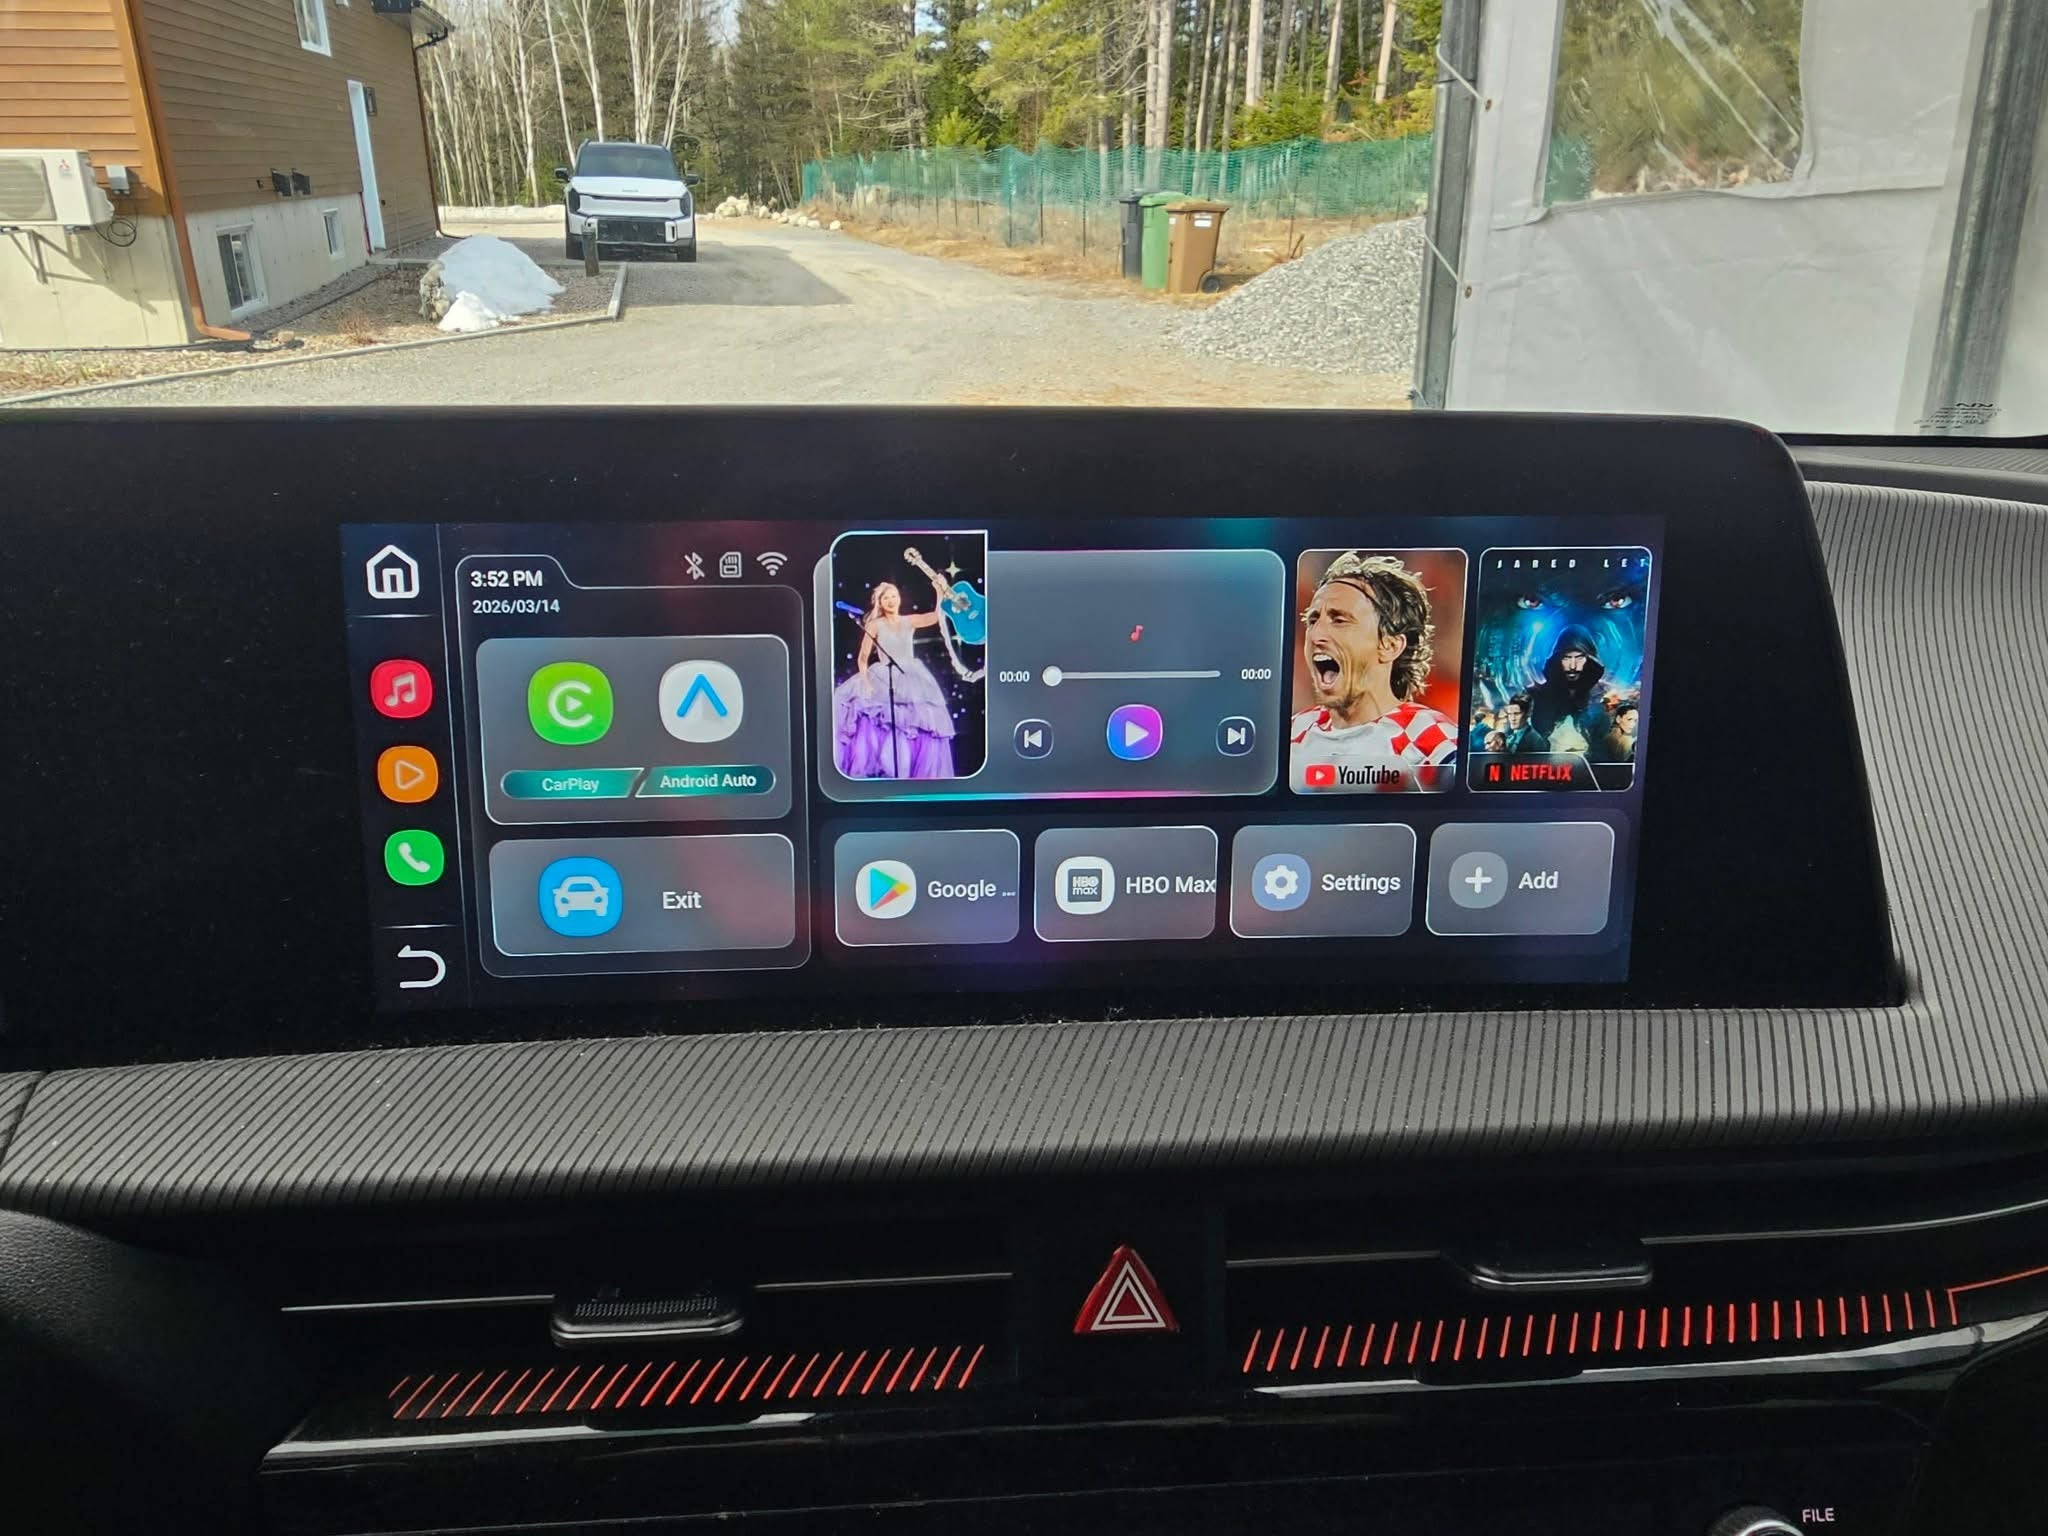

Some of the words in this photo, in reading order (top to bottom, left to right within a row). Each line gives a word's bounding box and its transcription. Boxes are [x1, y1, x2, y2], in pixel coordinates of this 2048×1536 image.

[1497, 559, 1576, 569] JARED
[470, 570, 509, 587] 3:52
[513, 570, 543, 587] PM
[472, 599, 560, 614] 2026/03/14
[1000, 671, 1030, 683] 00:00
[1241, 668, 1271, 681] 00:00
[659, 773, 718, 788] Android
[721, 773, 757, 788] Auto
[1338, 765, 1400, 785] YouTube
[1510, 764, 1572, 781] NETFLIX
[541, 777, 600, 793] CarPlay
[1072, 876, 1099, 888] HBO
[1125, 876, 1170, 894] HBO
[1175, 875, 1216, 893] Max
[1320, 872, 1401, 893] Settings
[1518, 871, 1558, 890] Add
[927, 879, 997, 902] Google
[1072, 887, 1098, 896] max
[661, 890, 702, 910] Exit
[1802, 1507, 1836, 1524] FILE
